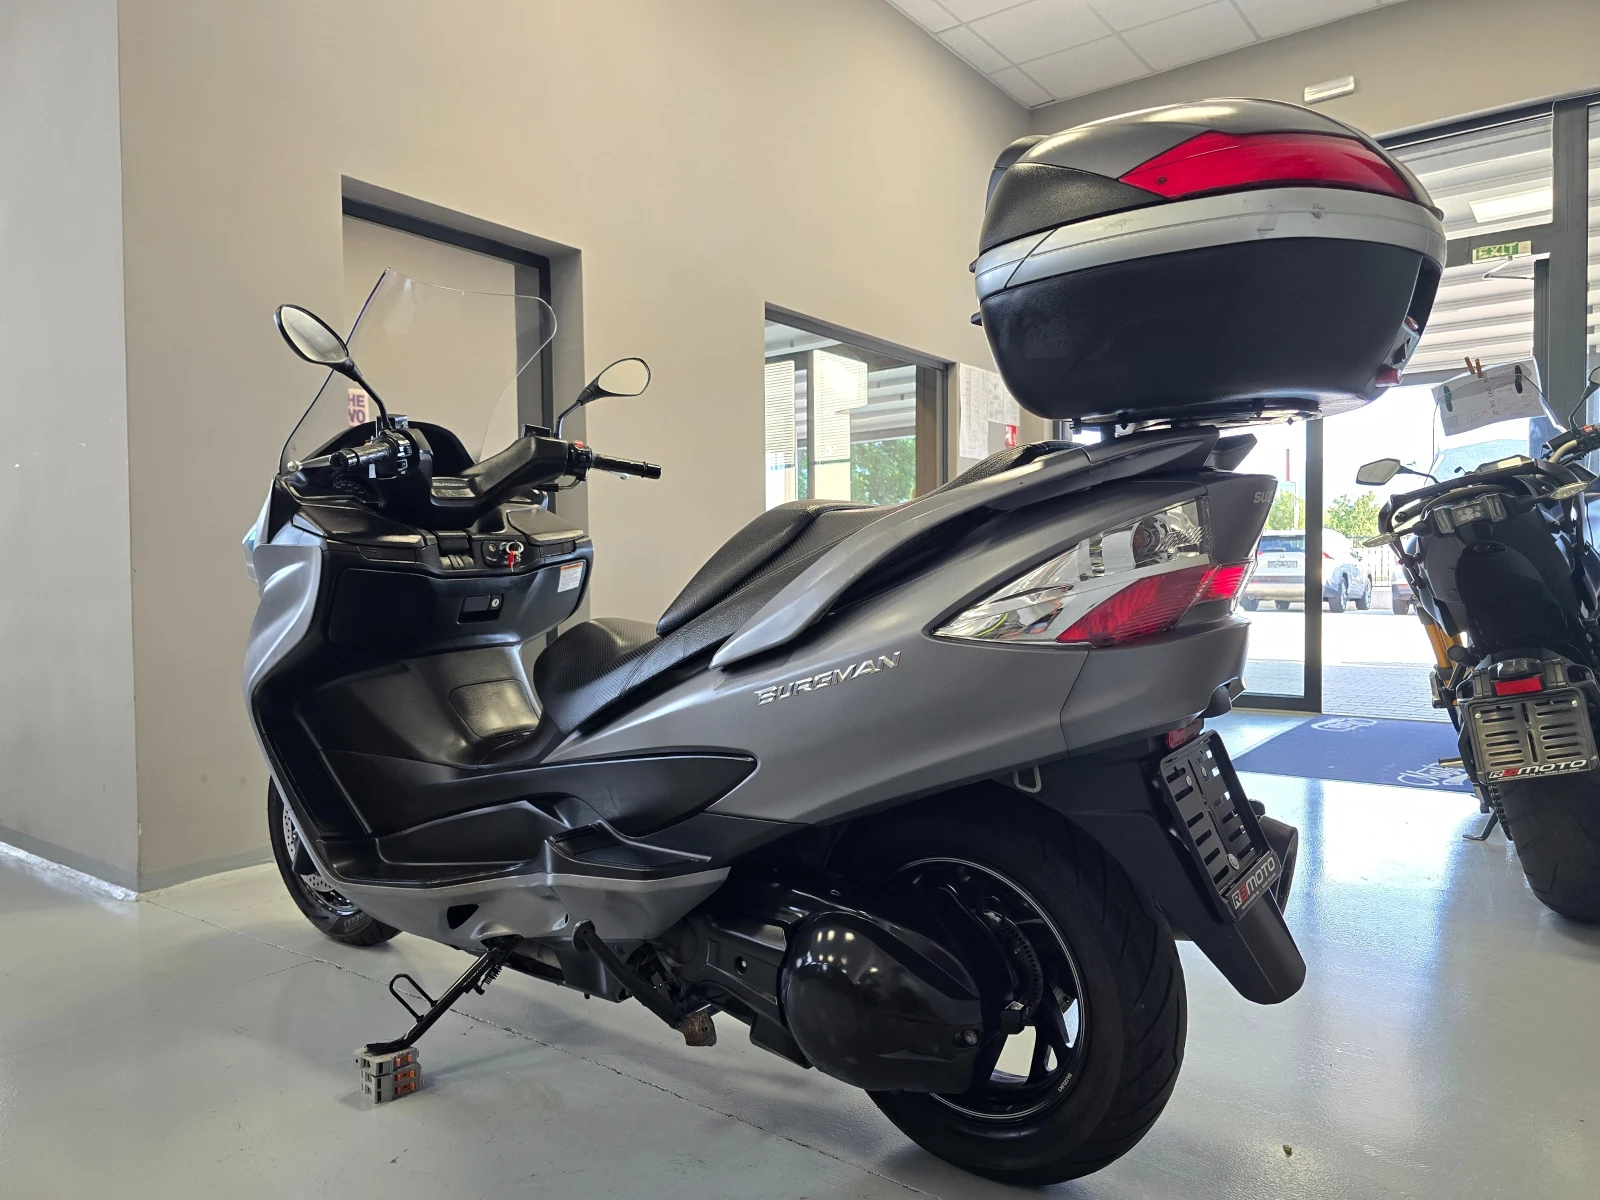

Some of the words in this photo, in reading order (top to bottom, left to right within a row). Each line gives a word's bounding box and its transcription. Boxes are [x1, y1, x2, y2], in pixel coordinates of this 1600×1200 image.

[1479, 242, 1518, 259] EXIT
[1253, 490, 1275, 504] SUZ
[754, 651, 901, 706] BURGMAN
